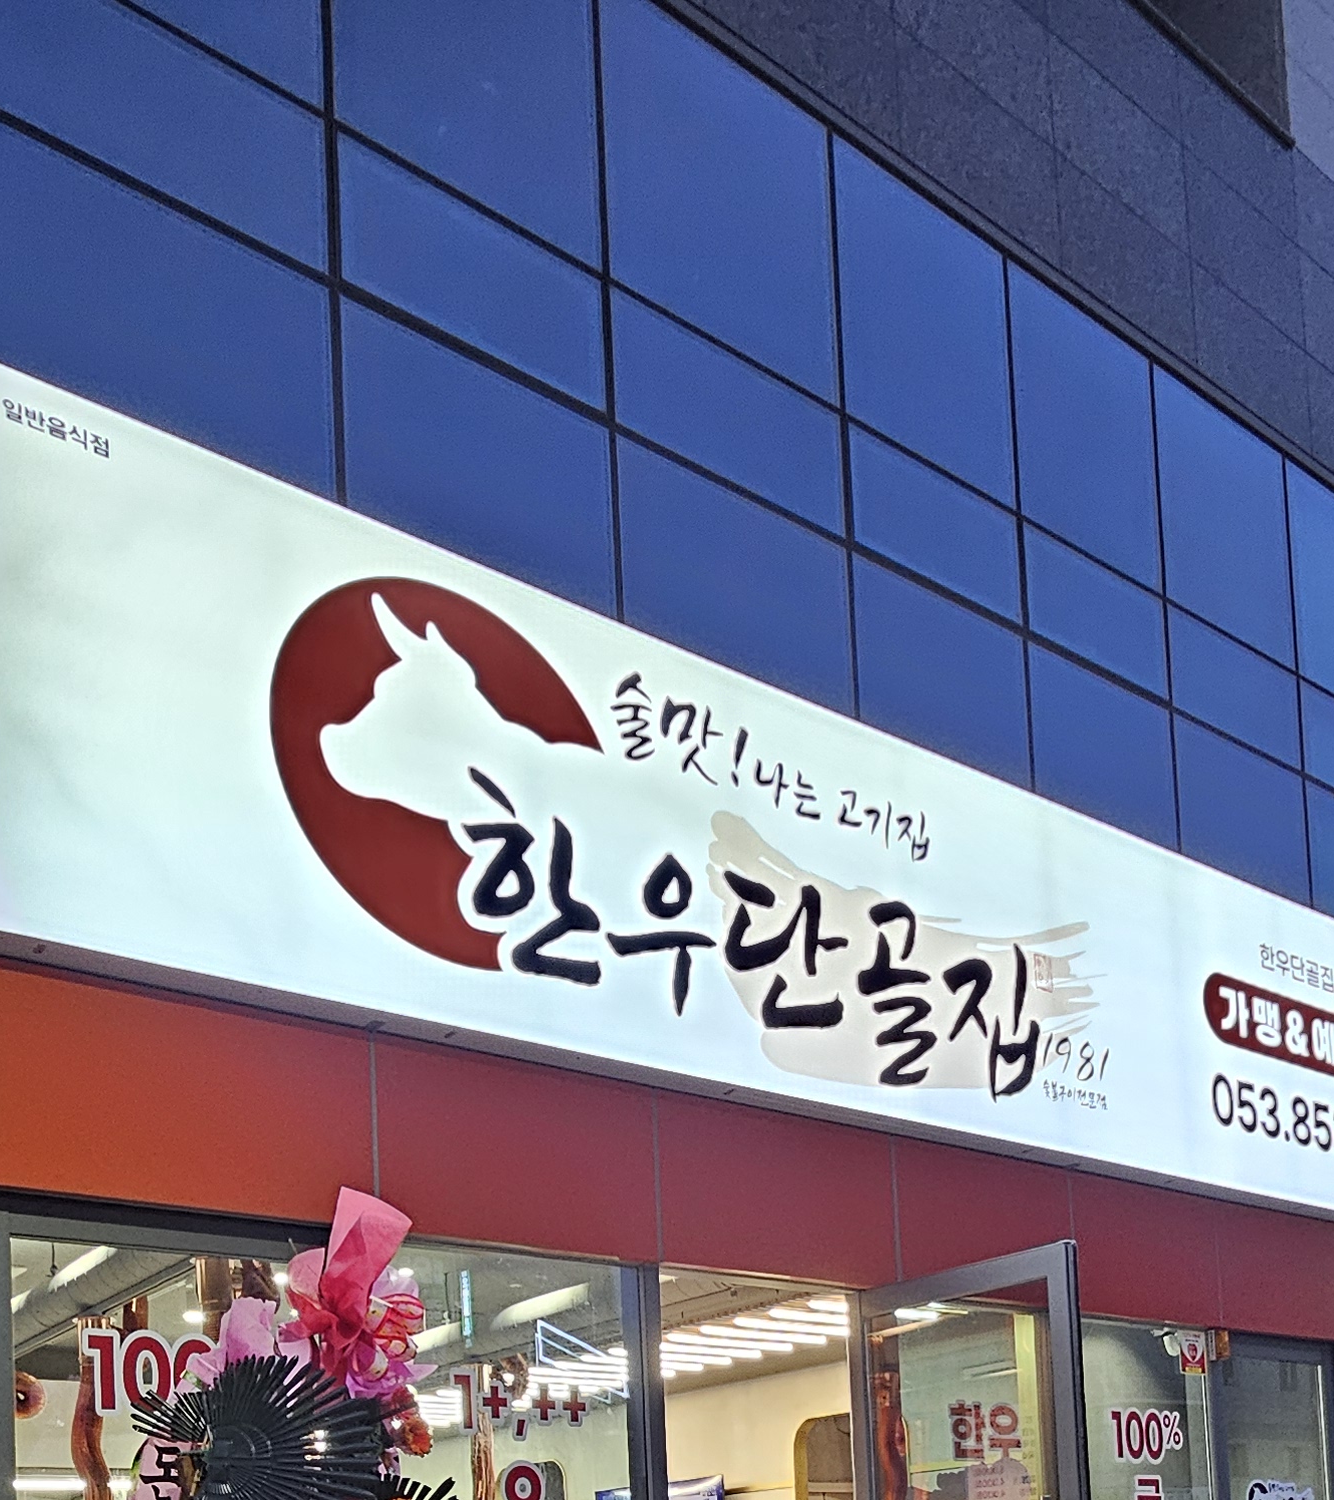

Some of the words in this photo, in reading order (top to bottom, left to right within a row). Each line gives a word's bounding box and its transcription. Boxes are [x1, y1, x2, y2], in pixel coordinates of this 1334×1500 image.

[2, 398, 111, 459] 일반음식점
[753, 760, 822, 821] 나는
[836, 790, 931, 863] 고기집
[462, 766, 1041, 1102] 한우단골집
[1259, 943, 1334, 993] 한우단골집
[1043, 1033, 1109, 1081] 1981
[1043, 1079, 1108, 1110] 숯불구이전문점
[1112, 1411, 1182, 1460] 100%
